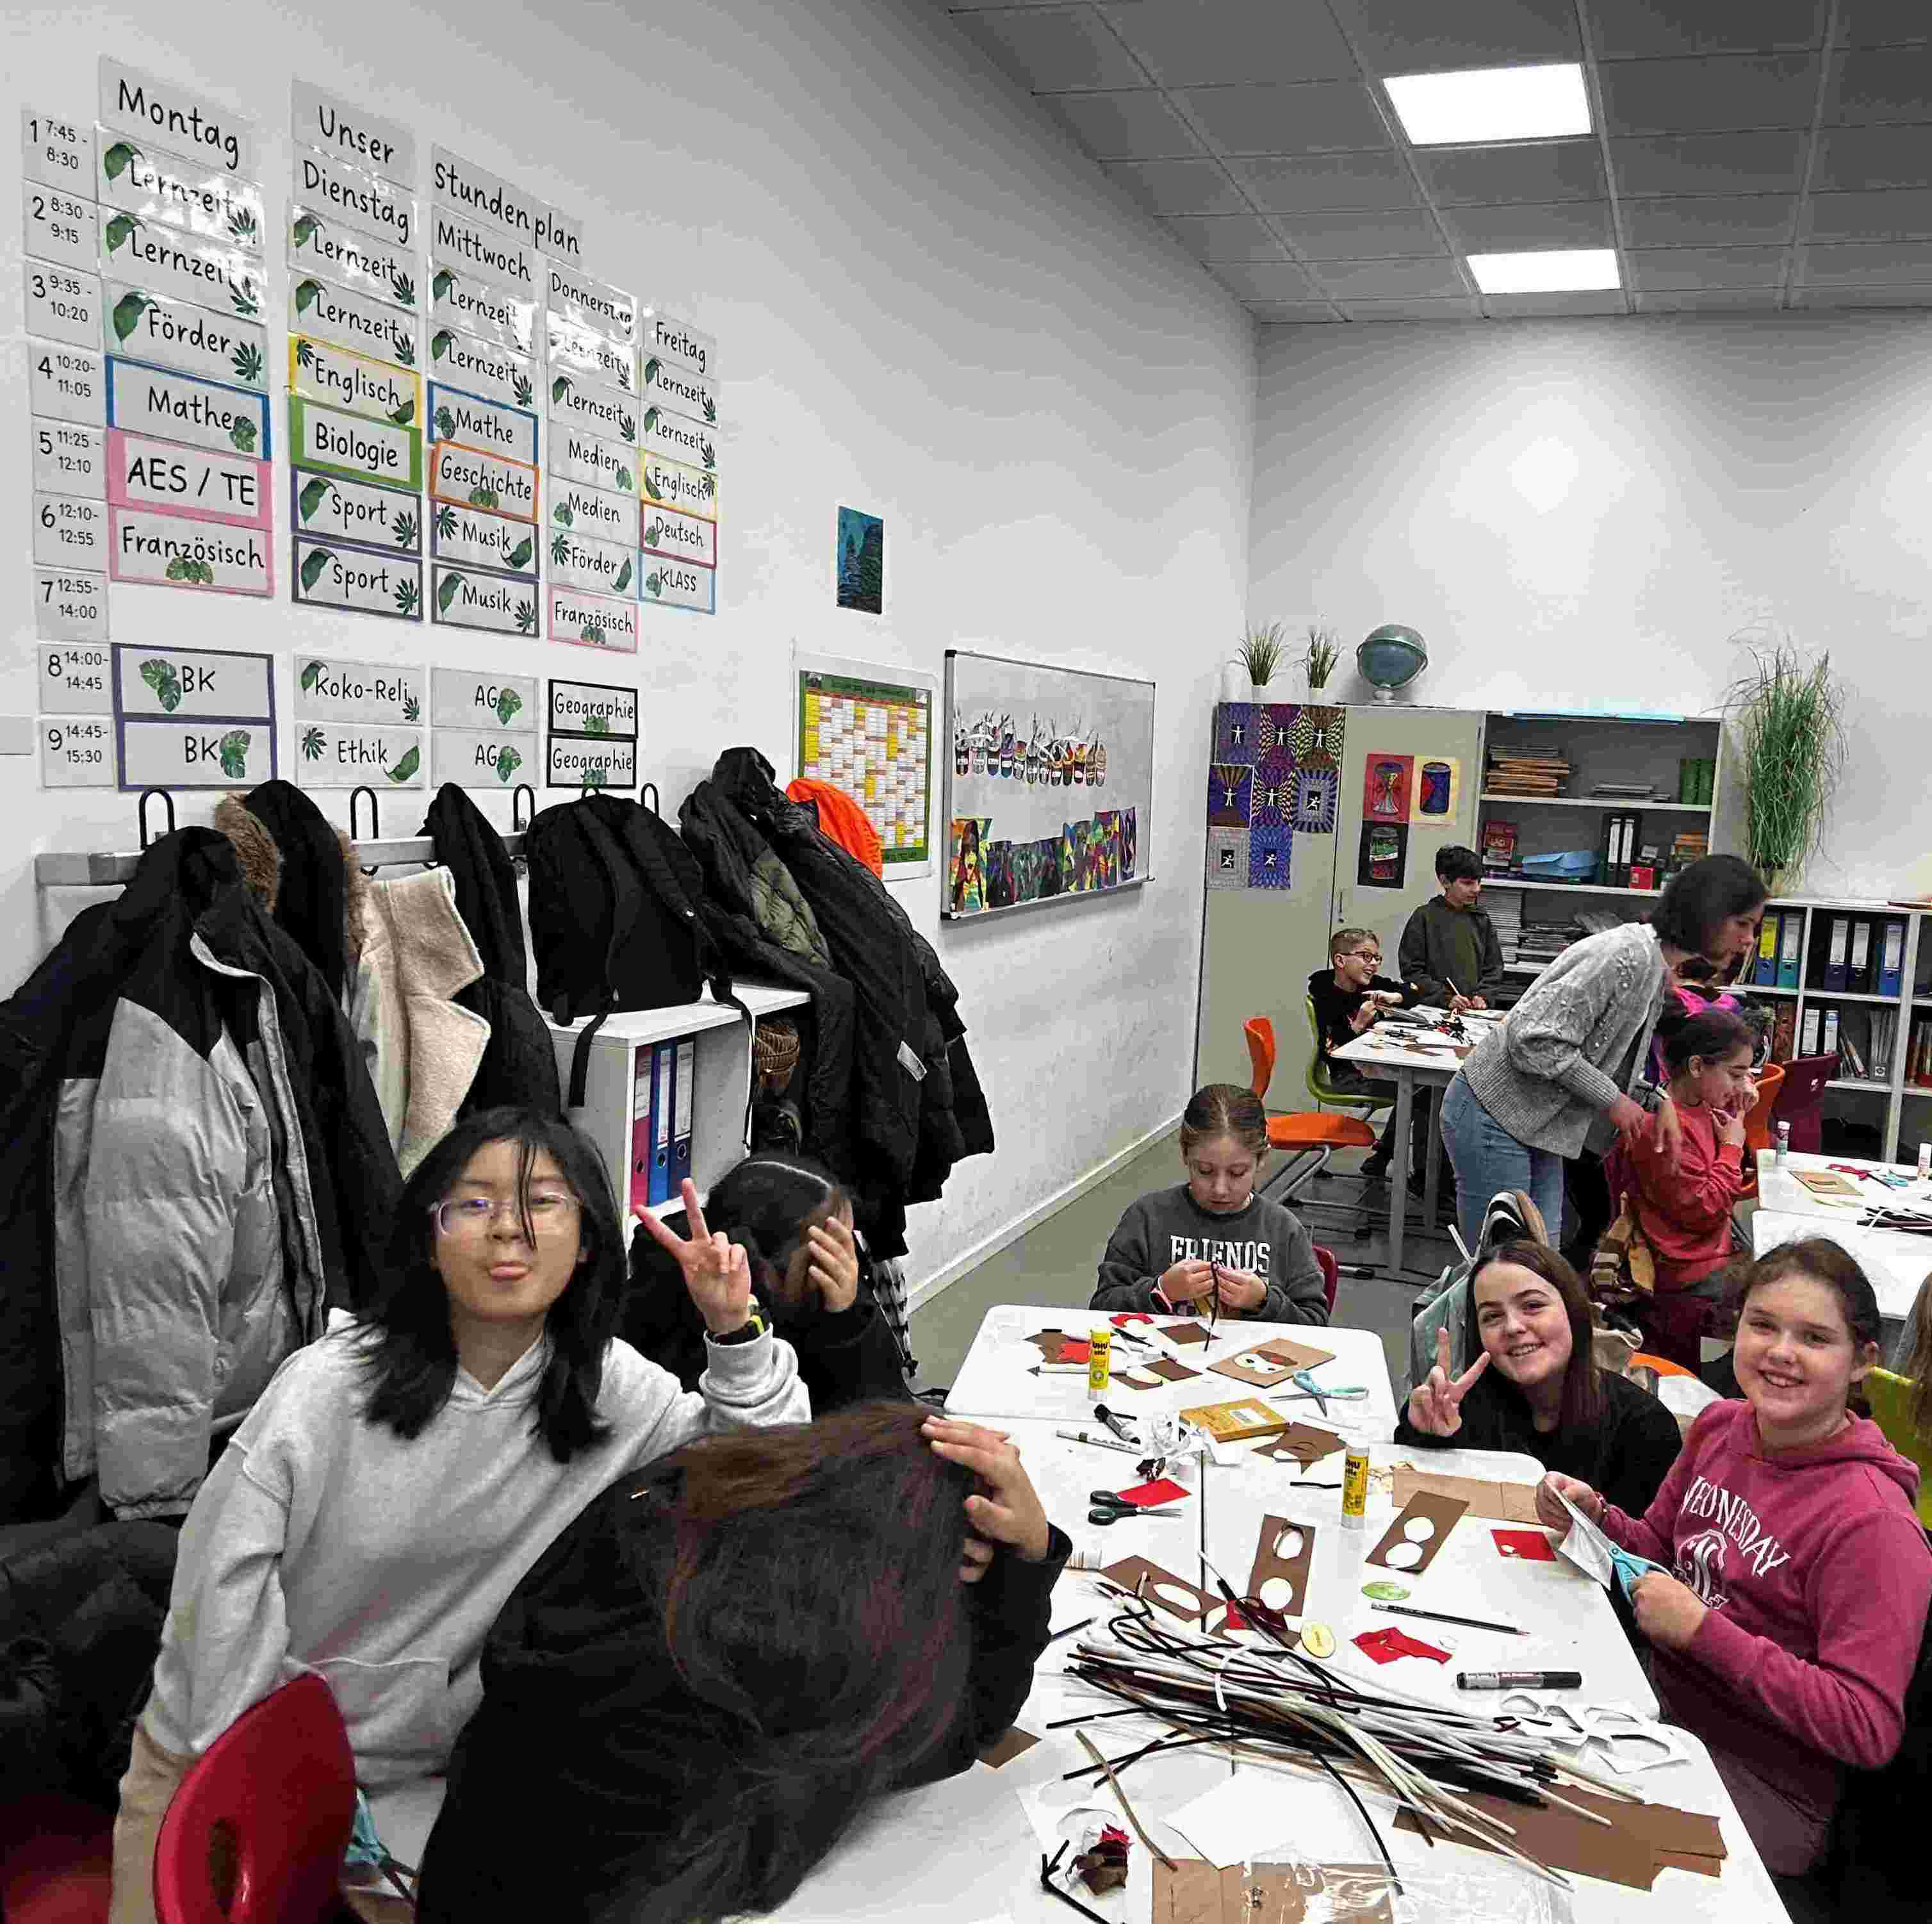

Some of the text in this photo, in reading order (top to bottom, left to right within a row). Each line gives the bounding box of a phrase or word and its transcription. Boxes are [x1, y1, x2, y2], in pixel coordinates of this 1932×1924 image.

[30, 119, 37, 143] 1
[45, 119, 76, 142] 7:45
[119, 79, 239, 170] Montag
[318, 105, 394, 163] Unser
[47, 147, 78, 169] 8:30
[32, 196, 45, 220] 2
[51, 199, 82, 219] 8:30
[304, 159, 409, 243] Dienstag
[51, 224, 79, 244] 9:15
[315, 227, 398, 282] Lernzeit
[438, 220, 531, 281] Mittwoch
[32, 275, 46, 297] 3
[50, 275, 81, 295] 9:35
[51, 302, 88, 323] 10:20
[318, 293, 398, 343] Lernzeit
[149, 309, 230, 353] Förder
[450, 340, 517, 384] Lernzeit
[565, 336, 620, 374] Lezeit
[656, 322, 705, 374] Freitag
[38, 357, 53, 380] 4
[316, 358, 400, 406] Englisch
[58, 380, 92, 397] 11:05
[657, 369, 706, 406] Lernzeit
[149, 386, 234, 430] Mathe
[567, 386, 623, 425] Lernzeit
[457, 408, 512, 443] Mathe
[656, 420, 705, 450] Lernzeit
[40, 432, 53, 454] 5
[316, 422, 398, 470] Biologie
[569, 440, 619, 471] Medien
[59, 457, 91, 473] 12:10
[442, 456, 532, 500] Geschichte
[127, 457, 254, 506] AES / TE
[655, 467, 705, 502] Englisch
[42, 504, 55, 527] 6
[332, 494, 386, 529] Sport
[569, 493, 620, 522] Medien
[60, 530, 94, 546] 12:55
[463, 522, 512, 552] Musik
[656, 517, 703, 547] Deutsch
[123, 527, 264, 568] Französisch
[571, 547, 617, 574] Förder
[42, 582, 53, 602] 7
[333, 563, 388, 598] Sport
[60, 604, 97, 619] 14:00
[463, 586, 512, 613] Musik
[555, 602, 634, 634] Französisch
[48, 655, 61, 677] 8
[182, 666, 215, 693] BK
[66, 677, 102, 690] 14:45
[316, 673, 409, 702] Koko-Reli
[475, 686, 497, 708] AG
[555, 693, 634, 724] Geographie
[48, 729, 61, 751] 9
[185, 735, 218, 762] BK
[338, 739, 388, 764] Ethik
[475, 744, 497, 766] AG
[66, 750, 101, 763] 15:30
[553, 748, 632, 774] Geographie
[1170, 1235, 1270, 1273] FRIENDS
